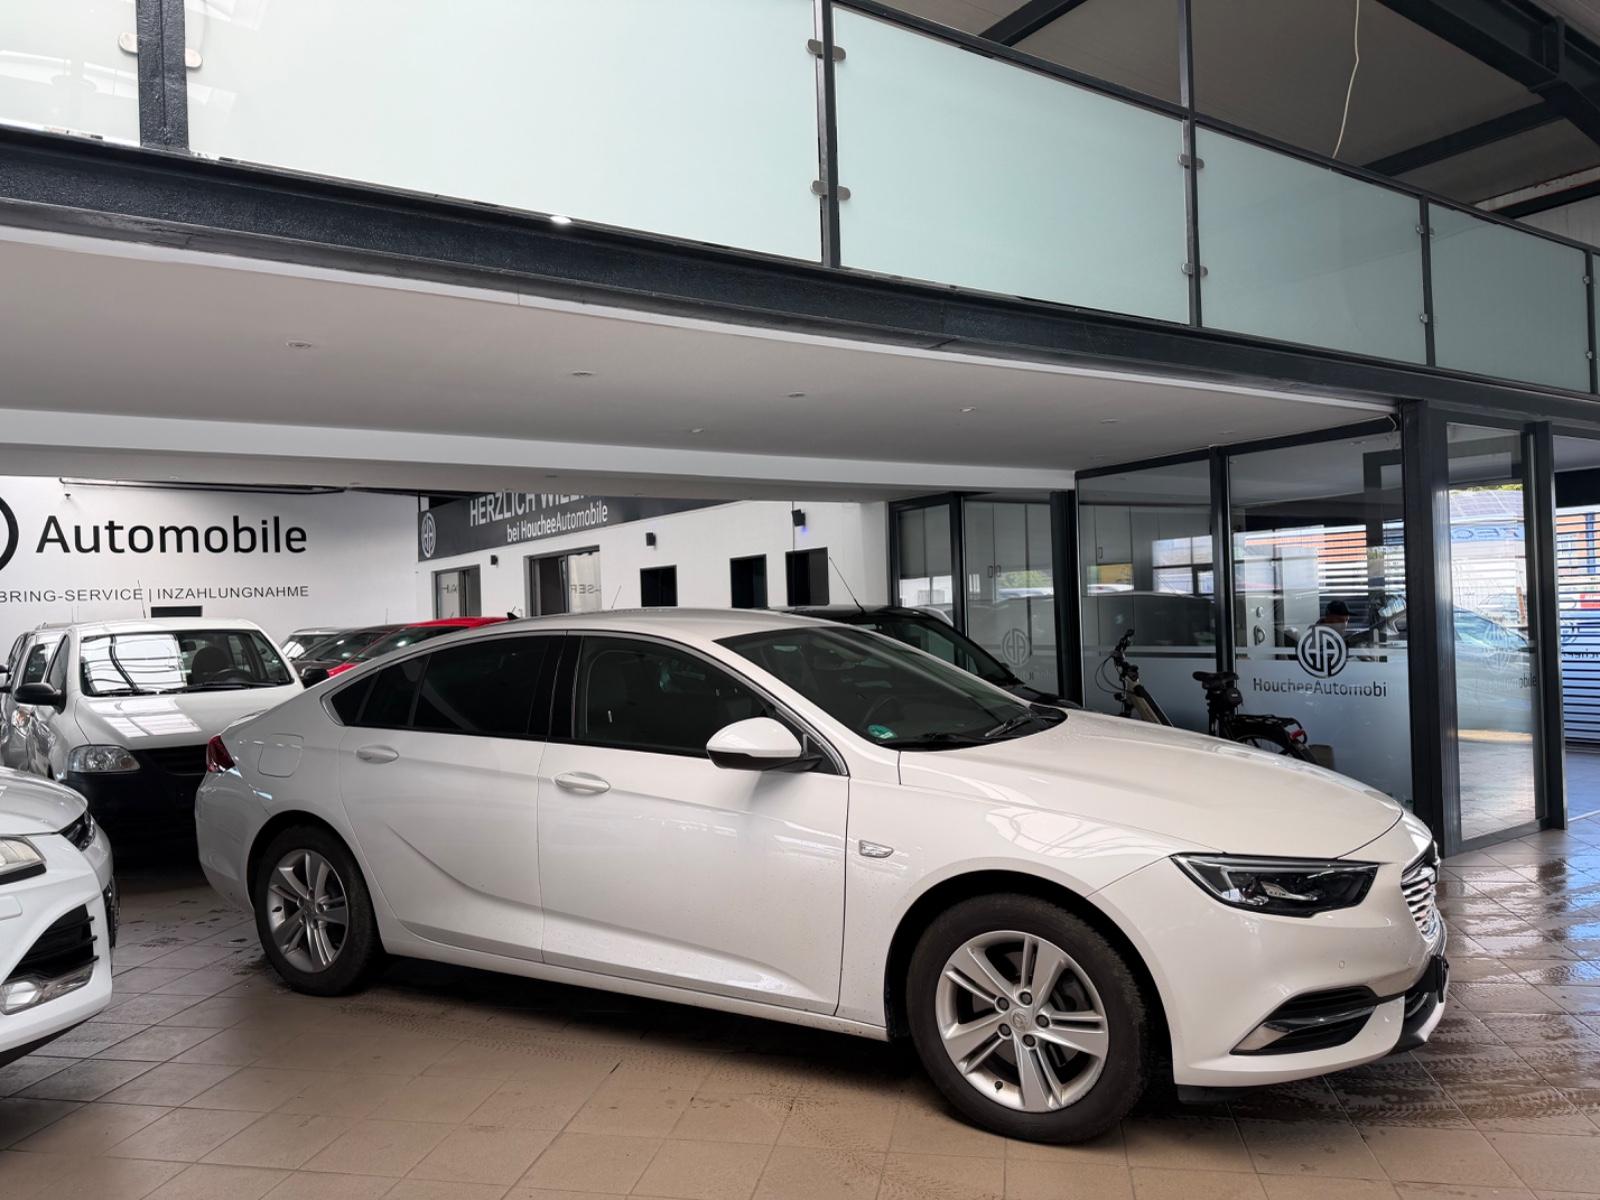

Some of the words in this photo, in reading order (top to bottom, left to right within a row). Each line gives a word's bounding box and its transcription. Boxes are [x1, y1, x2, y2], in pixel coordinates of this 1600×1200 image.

[470, 492, 535, 527] HERZLICH
[507, 524, 519, 542] bei
[521, 502, 608, 539] HoucheeAutomobile
[36, 515, 307, 553] Automobile
[0, 588, 143, 603] BRING-SERVICE
[157, 586, 309, 599] INZAHLUNGNAHME
